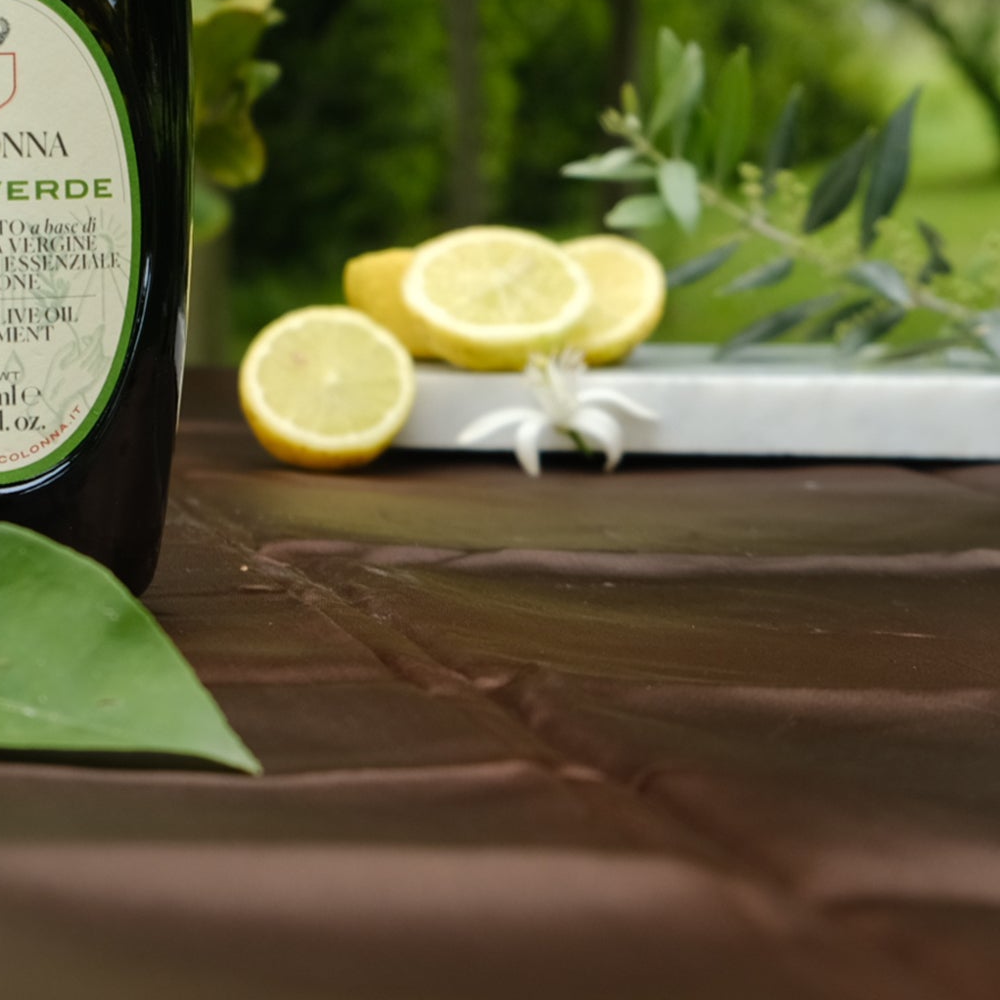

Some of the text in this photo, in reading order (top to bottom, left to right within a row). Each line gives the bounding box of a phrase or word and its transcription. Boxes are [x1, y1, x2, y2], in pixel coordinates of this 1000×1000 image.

[30, 223, 40, 235] a
[44, 218, 78, 234] base
[82, 217, 97, 233] di
[7, 235, 98, 253] VERGINE
[4, 252, 121, 273] ESSENZIALE
[44, 306, 79, 323] OIL
[14, 415, 46, 431] oz.
